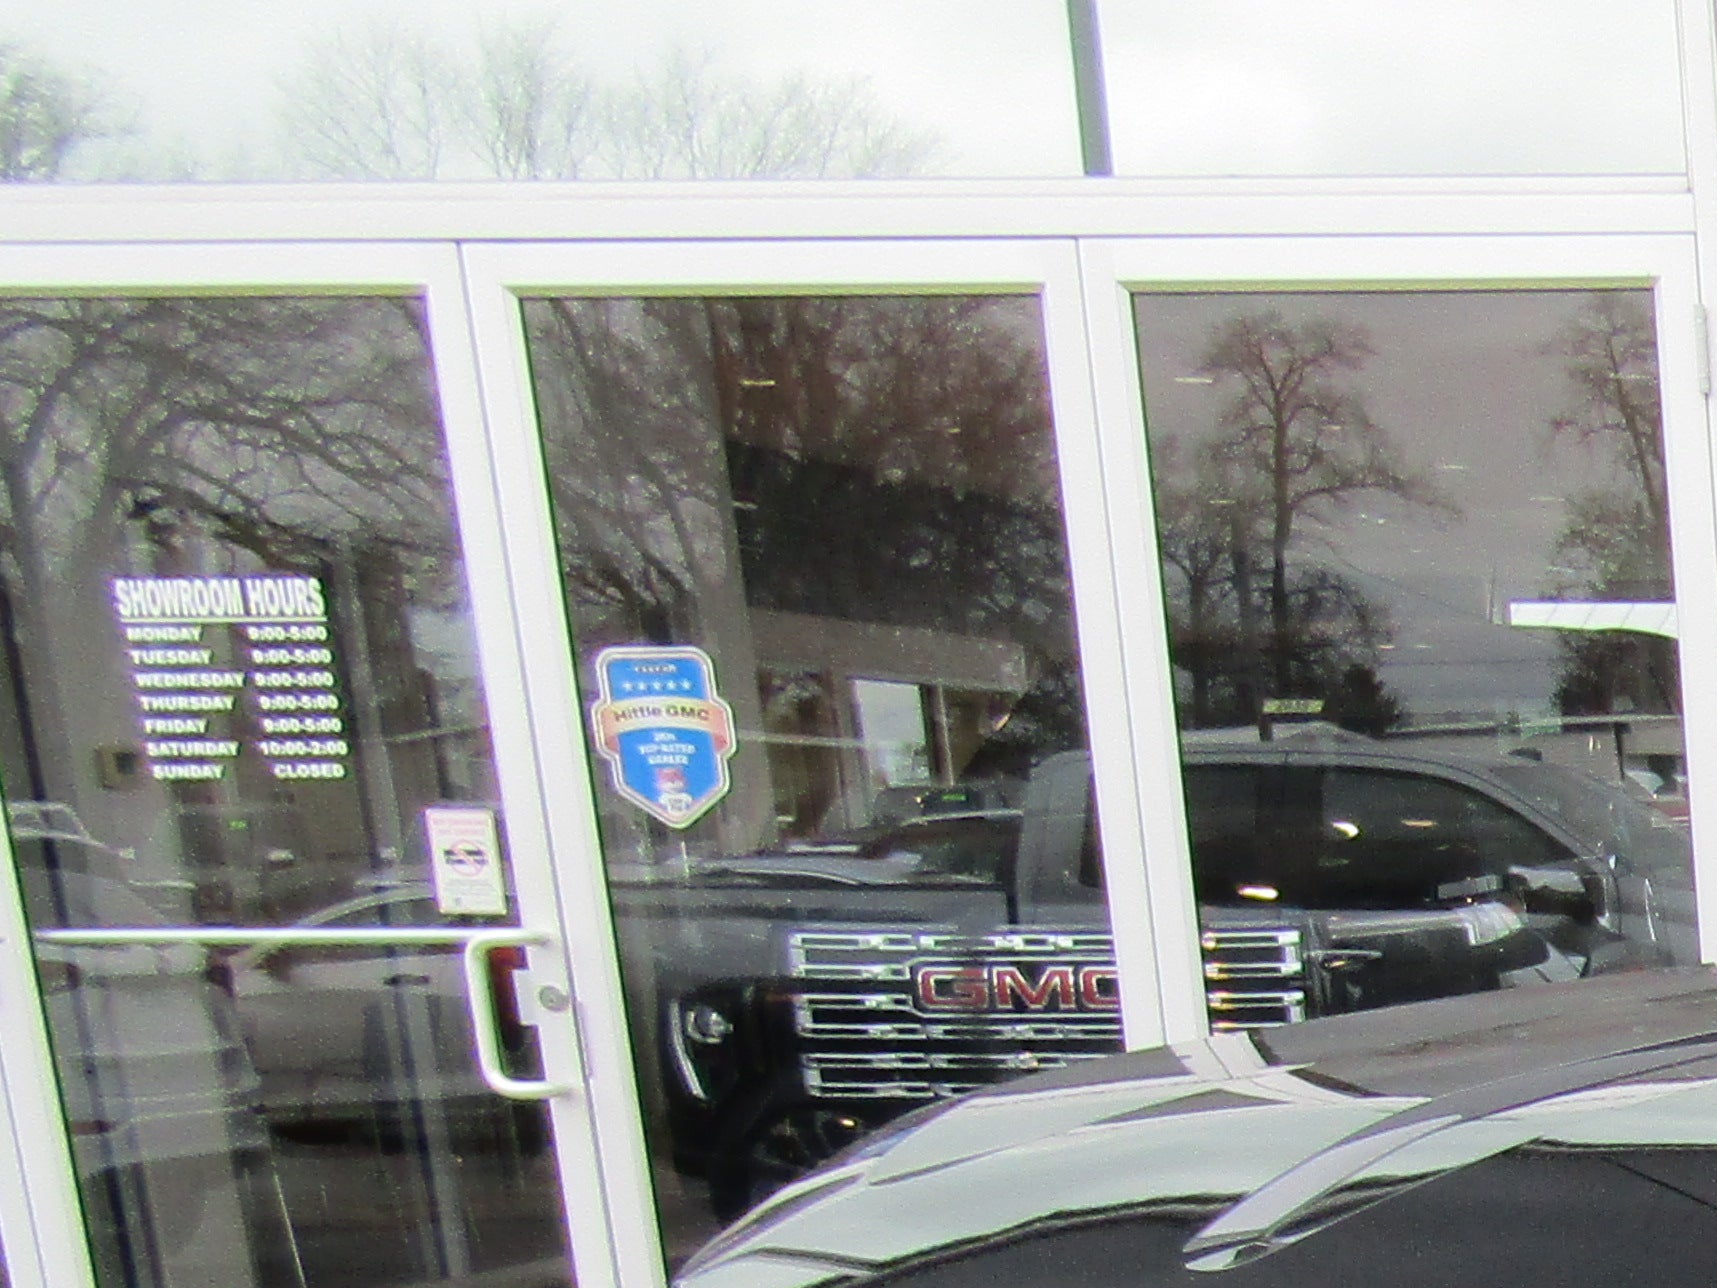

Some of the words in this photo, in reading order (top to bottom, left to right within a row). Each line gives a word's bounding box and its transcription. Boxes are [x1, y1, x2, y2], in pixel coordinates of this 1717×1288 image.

[114, 577, 244, 616] SHOWROOM
[246, 576, 325, 616] HOURS
[126, 626, 203, 641] MONDAY
[247, 625, 328, 641] 9:00-5:00
[131, 649, 213, 665] TUESDAY
[251, 648, 332, 664] 9:00-5:00
[136, 671, 246, 687] WEDNESDAY
[254, 671, 334, 687] 9:00-5:00
[140, 695, 235, 710] THURSDAY
[259, 694, 339, 710] 9:00-5:00
[615, 706, 662, 722] Hittle
[665, 705, 709, 721] GMC
[144, 718, 208, 733] FRIDAY
[263, 717, 343, 733] 9:00-5:00
[147, 741, 240, 756] SATURDAY
[260, 740, 349, 756] 10:00-2:00
[152, 763, 226, 779] SUNDAY
[273, 762, 346, 779] CLOSED
